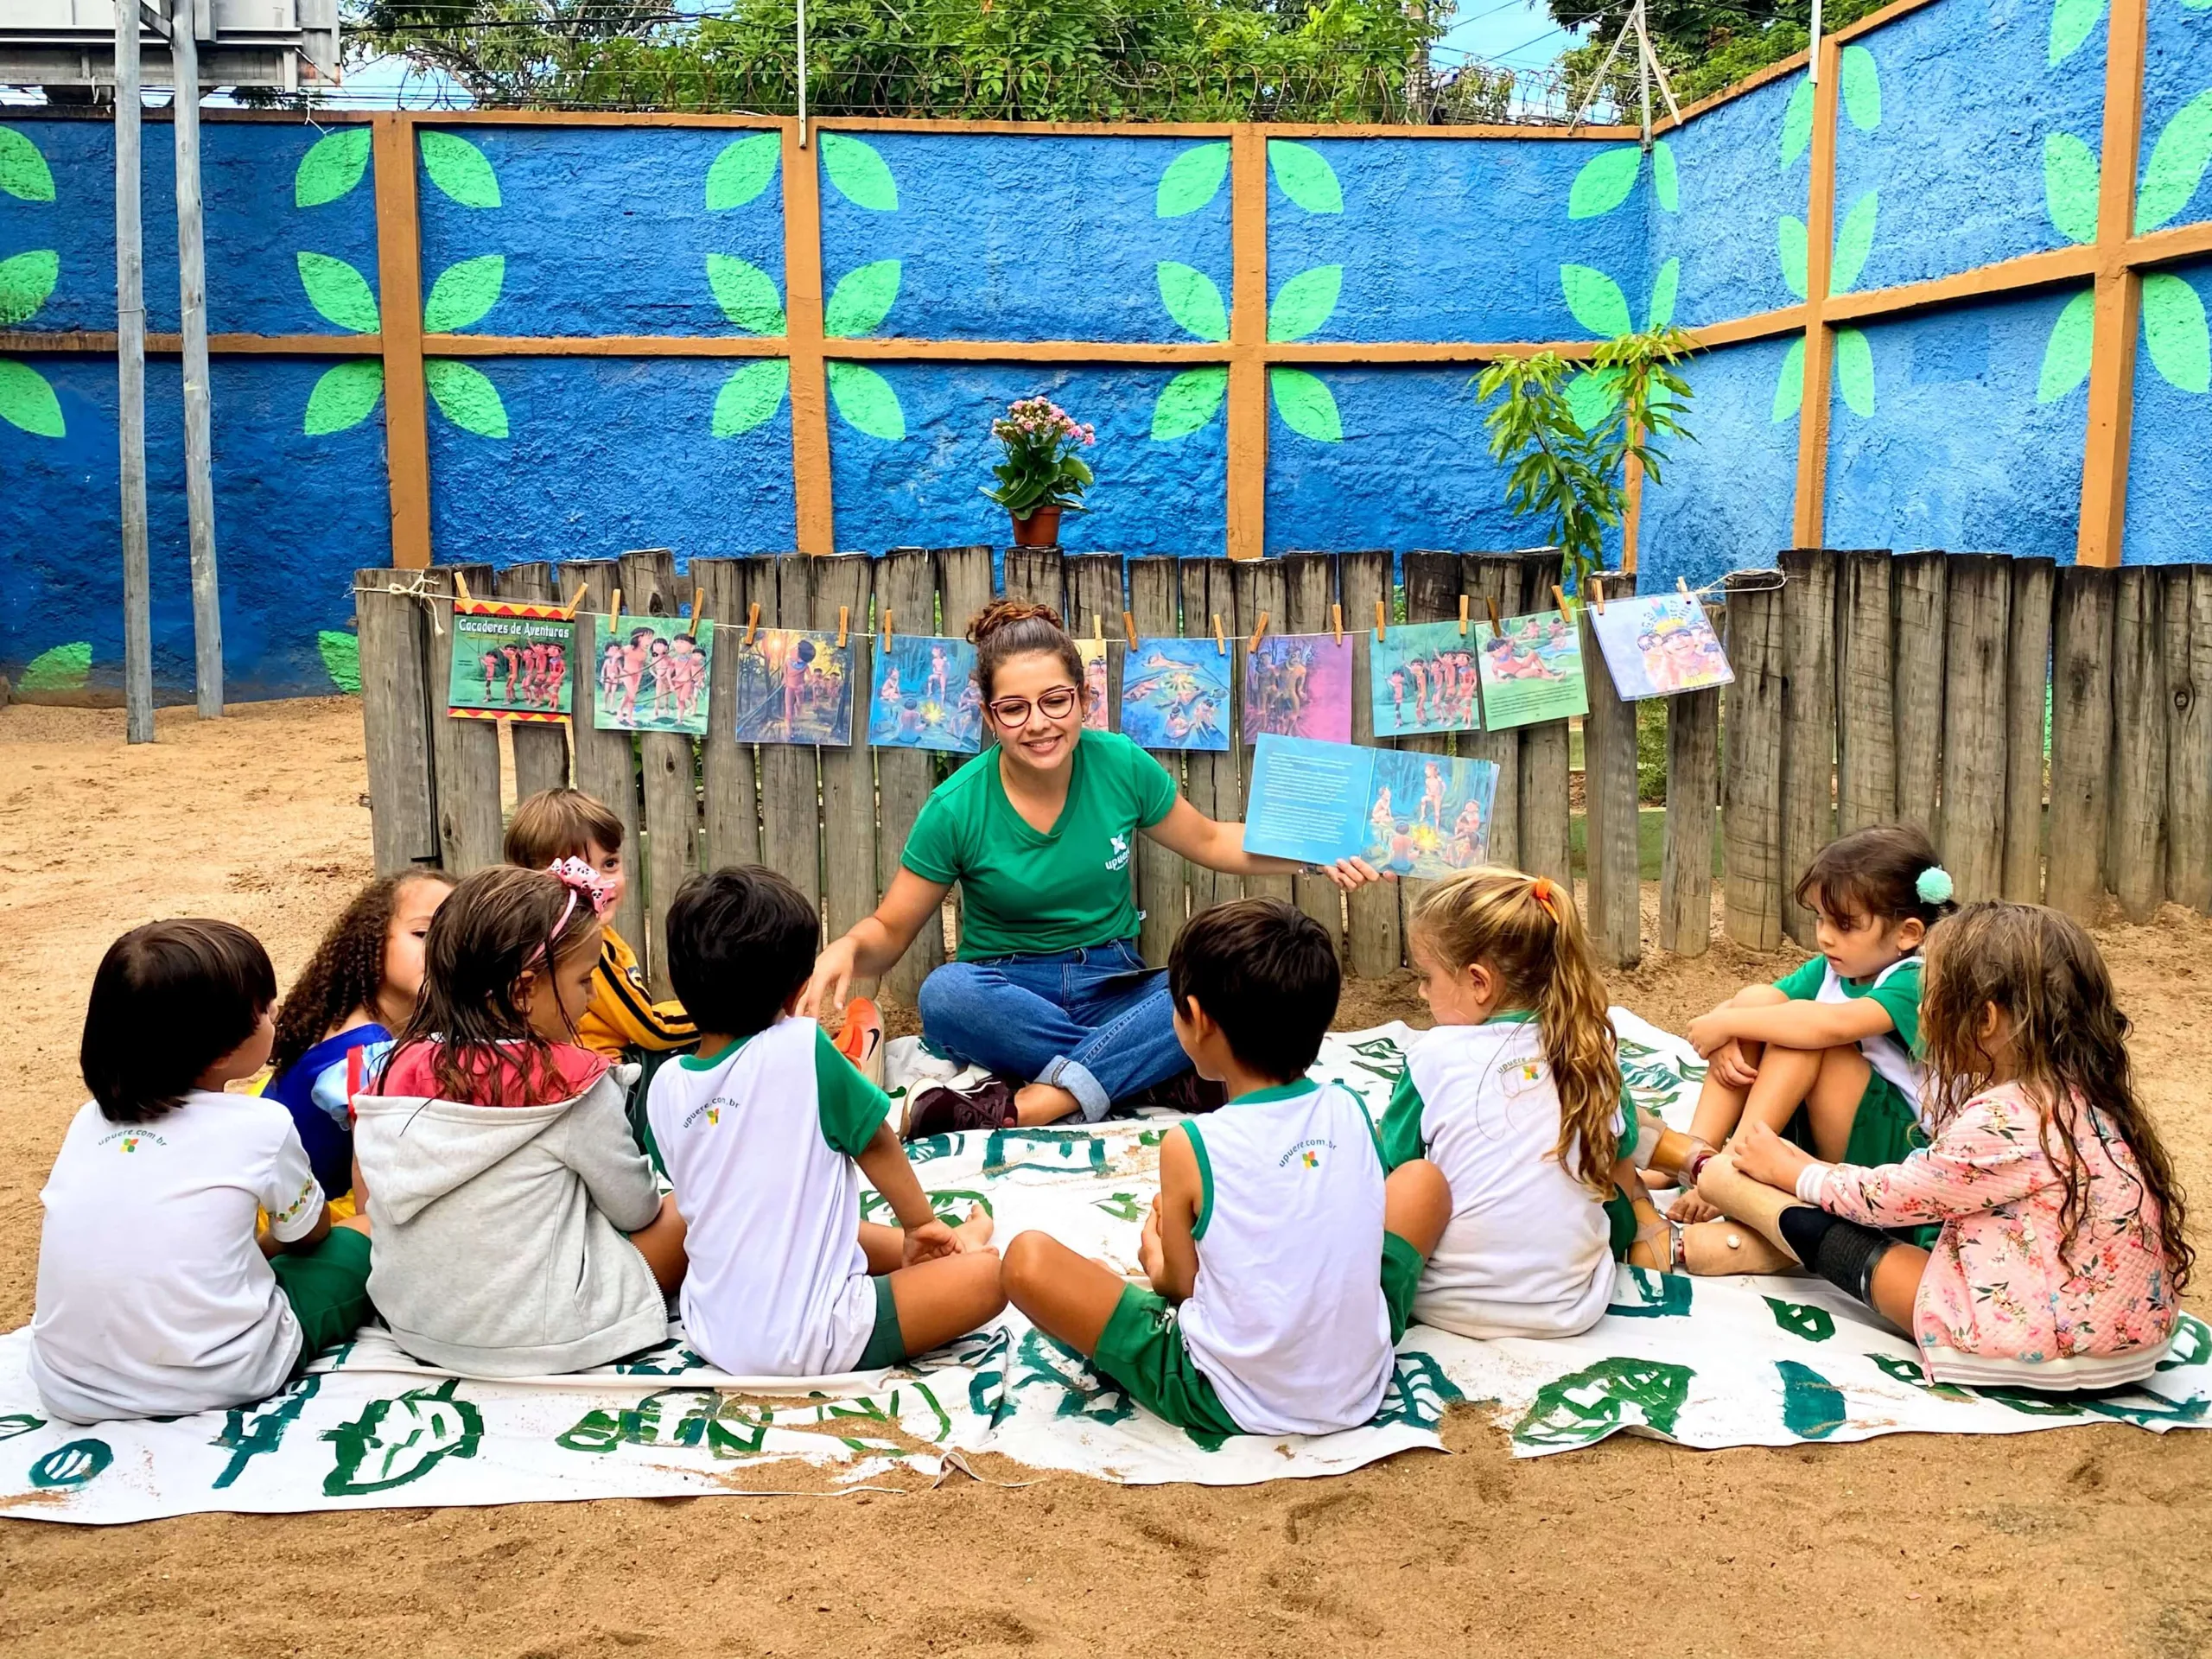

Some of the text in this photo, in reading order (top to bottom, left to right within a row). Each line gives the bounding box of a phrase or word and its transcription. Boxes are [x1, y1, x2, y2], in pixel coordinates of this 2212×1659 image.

[511, 622, 522, 635] de
[524, 622, 569, 639] Aventuras
[683, 1096, 741, 1128] upuere.com.br
[98, 1128, 168, 1147] upuere.com.br
[1279, 1139, 1338, 1167] upuere.com.br
